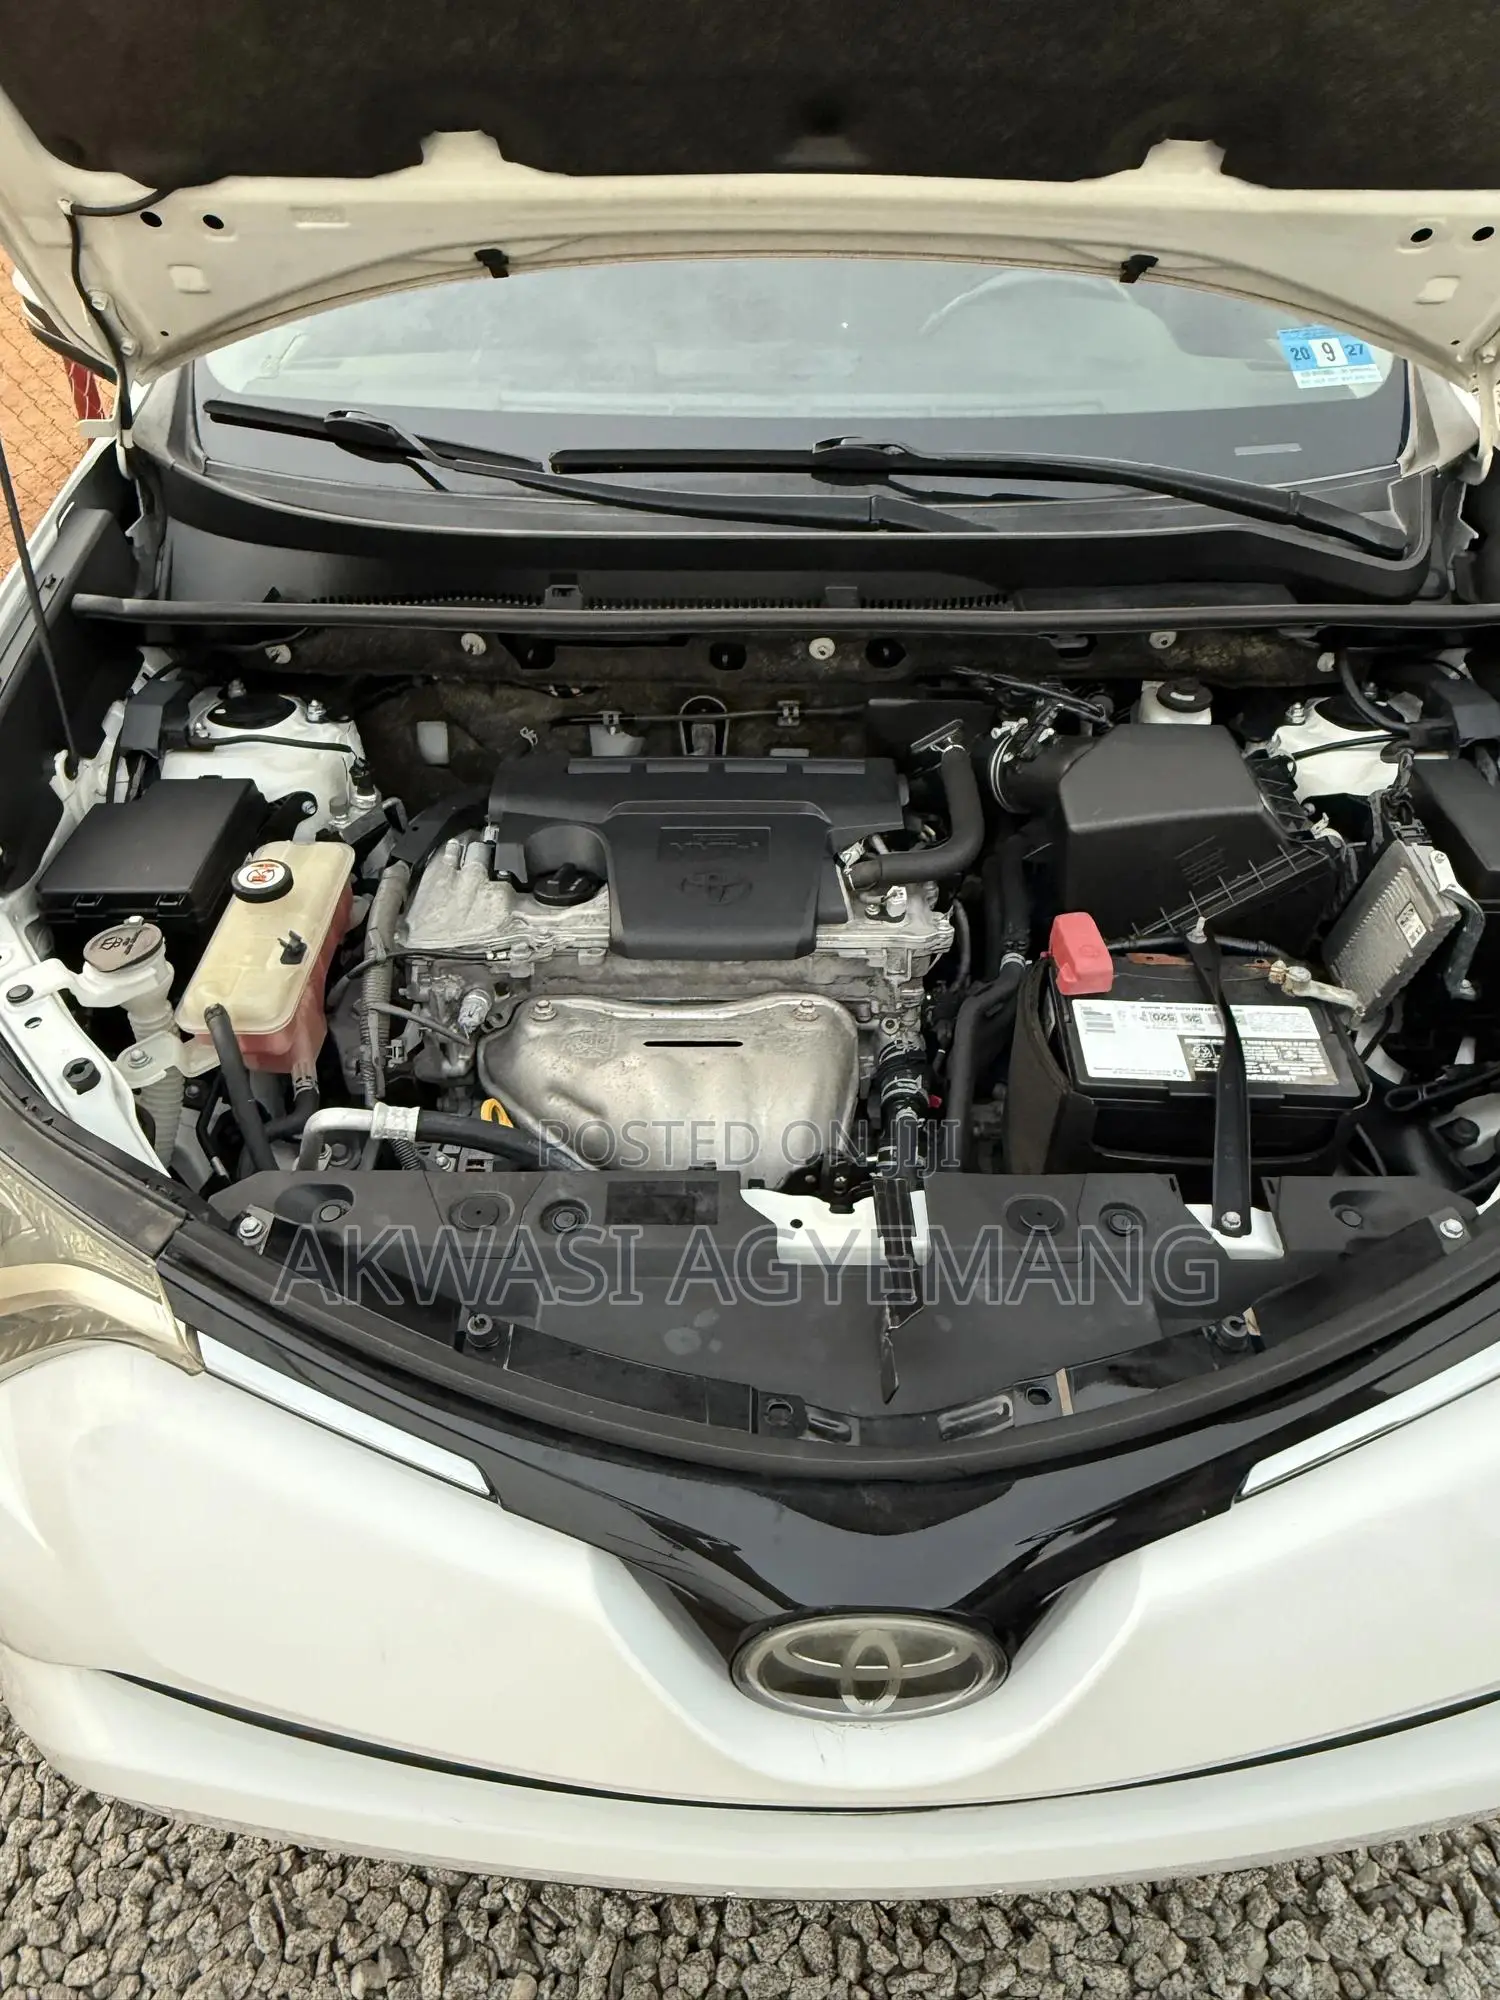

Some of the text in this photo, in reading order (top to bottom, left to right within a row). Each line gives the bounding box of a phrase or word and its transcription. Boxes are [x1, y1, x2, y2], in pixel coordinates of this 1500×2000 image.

[1290, 342, 1364, 361] 20 9 27
